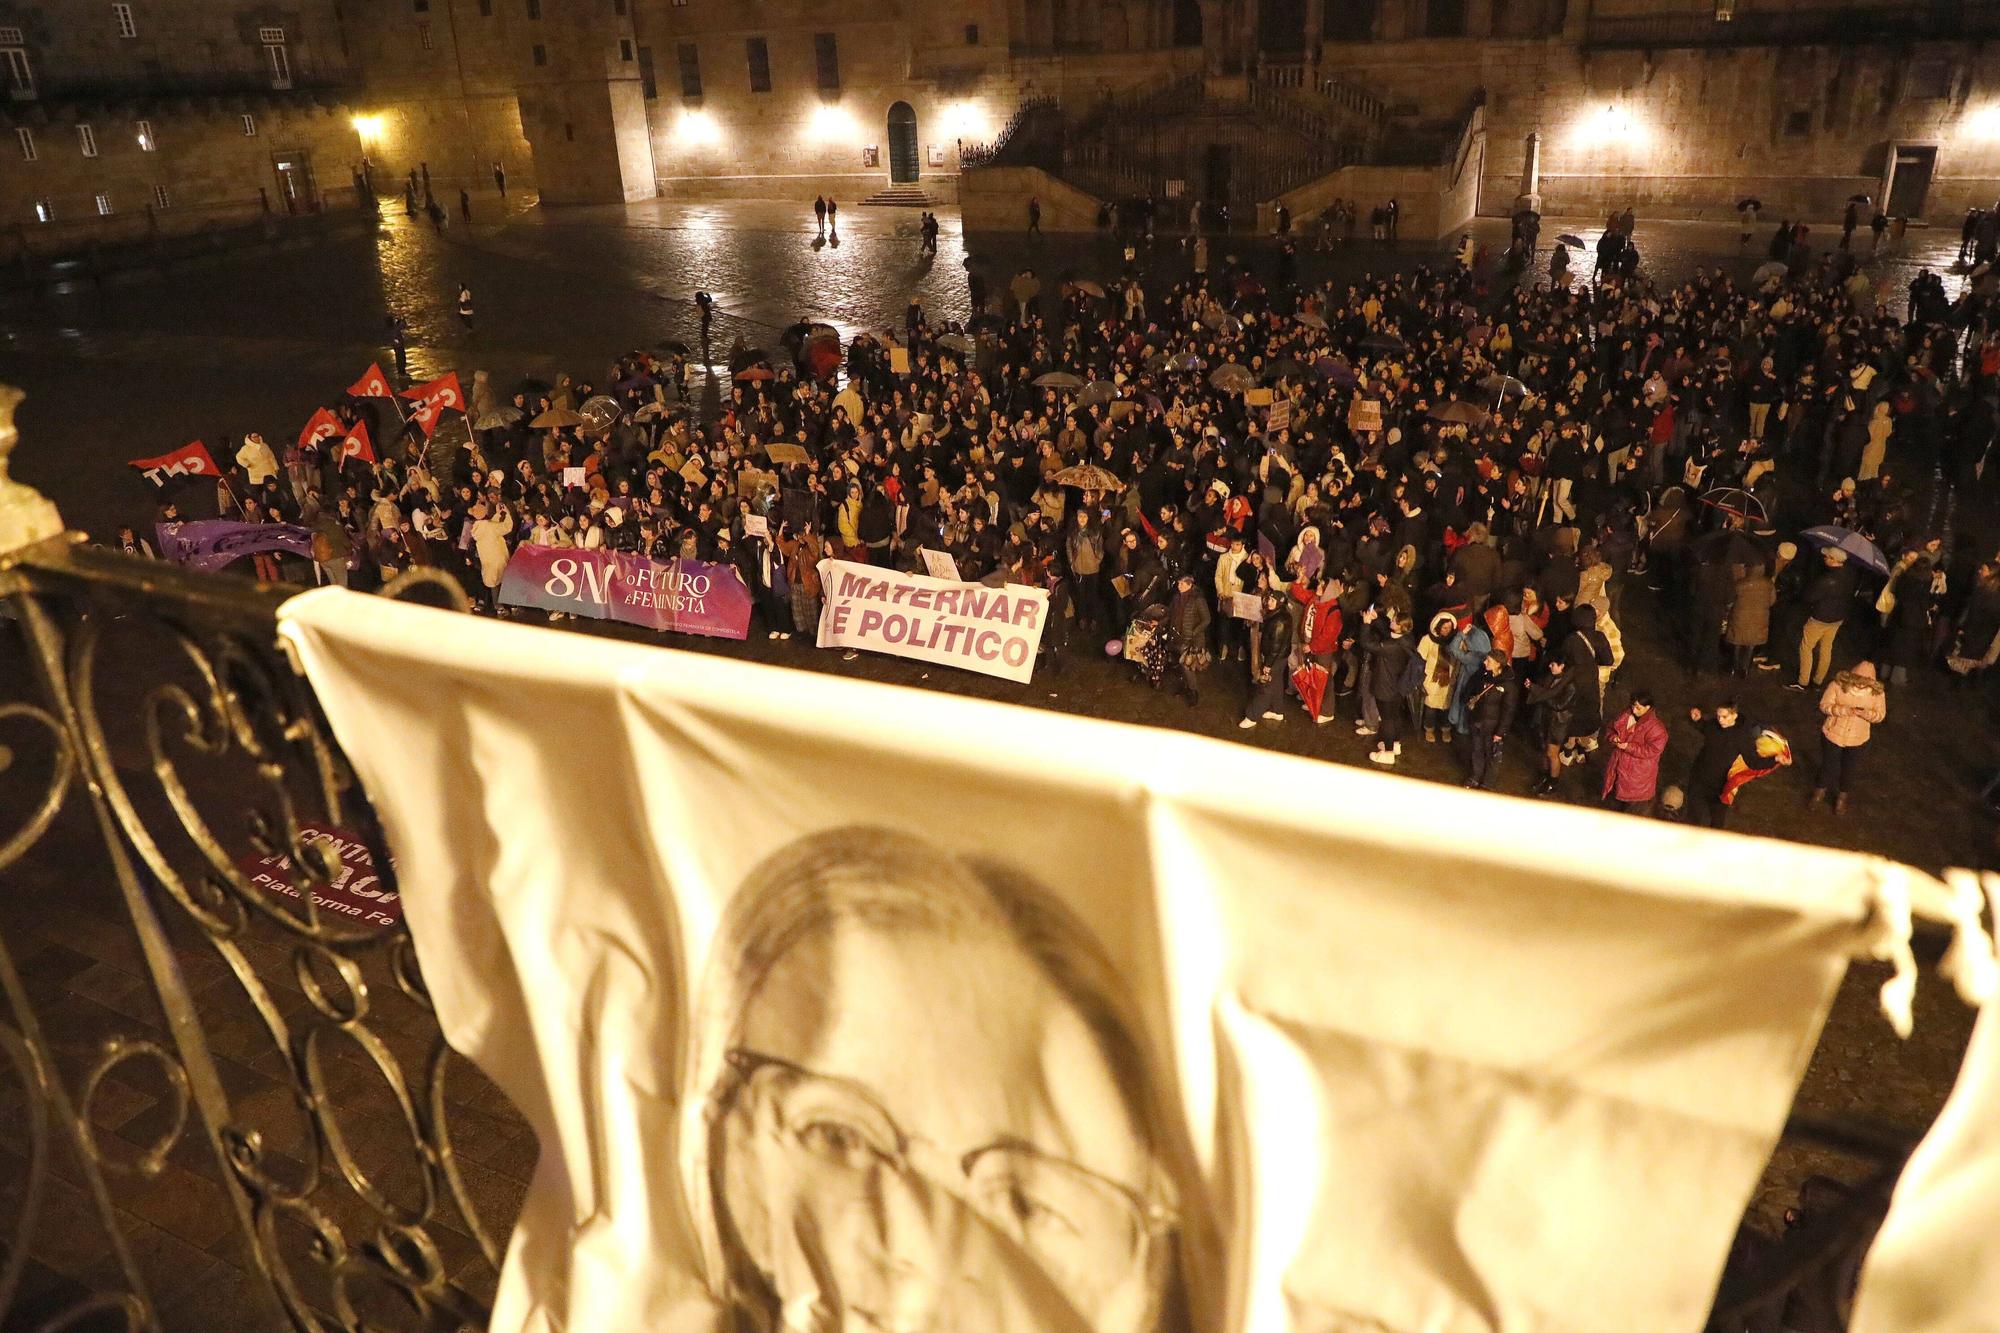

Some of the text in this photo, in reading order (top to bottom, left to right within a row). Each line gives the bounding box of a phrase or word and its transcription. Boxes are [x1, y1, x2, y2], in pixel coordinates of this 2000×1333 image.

[632, 590, 705, 615] FEMINISTA
[636, 568, 710, 598] FUTURO
[838, 571, 1040, 630] MATERNAR
[832, 599, 1030, 668] É POLÍTICO
[251, 873, 363, 916] Plataorma
